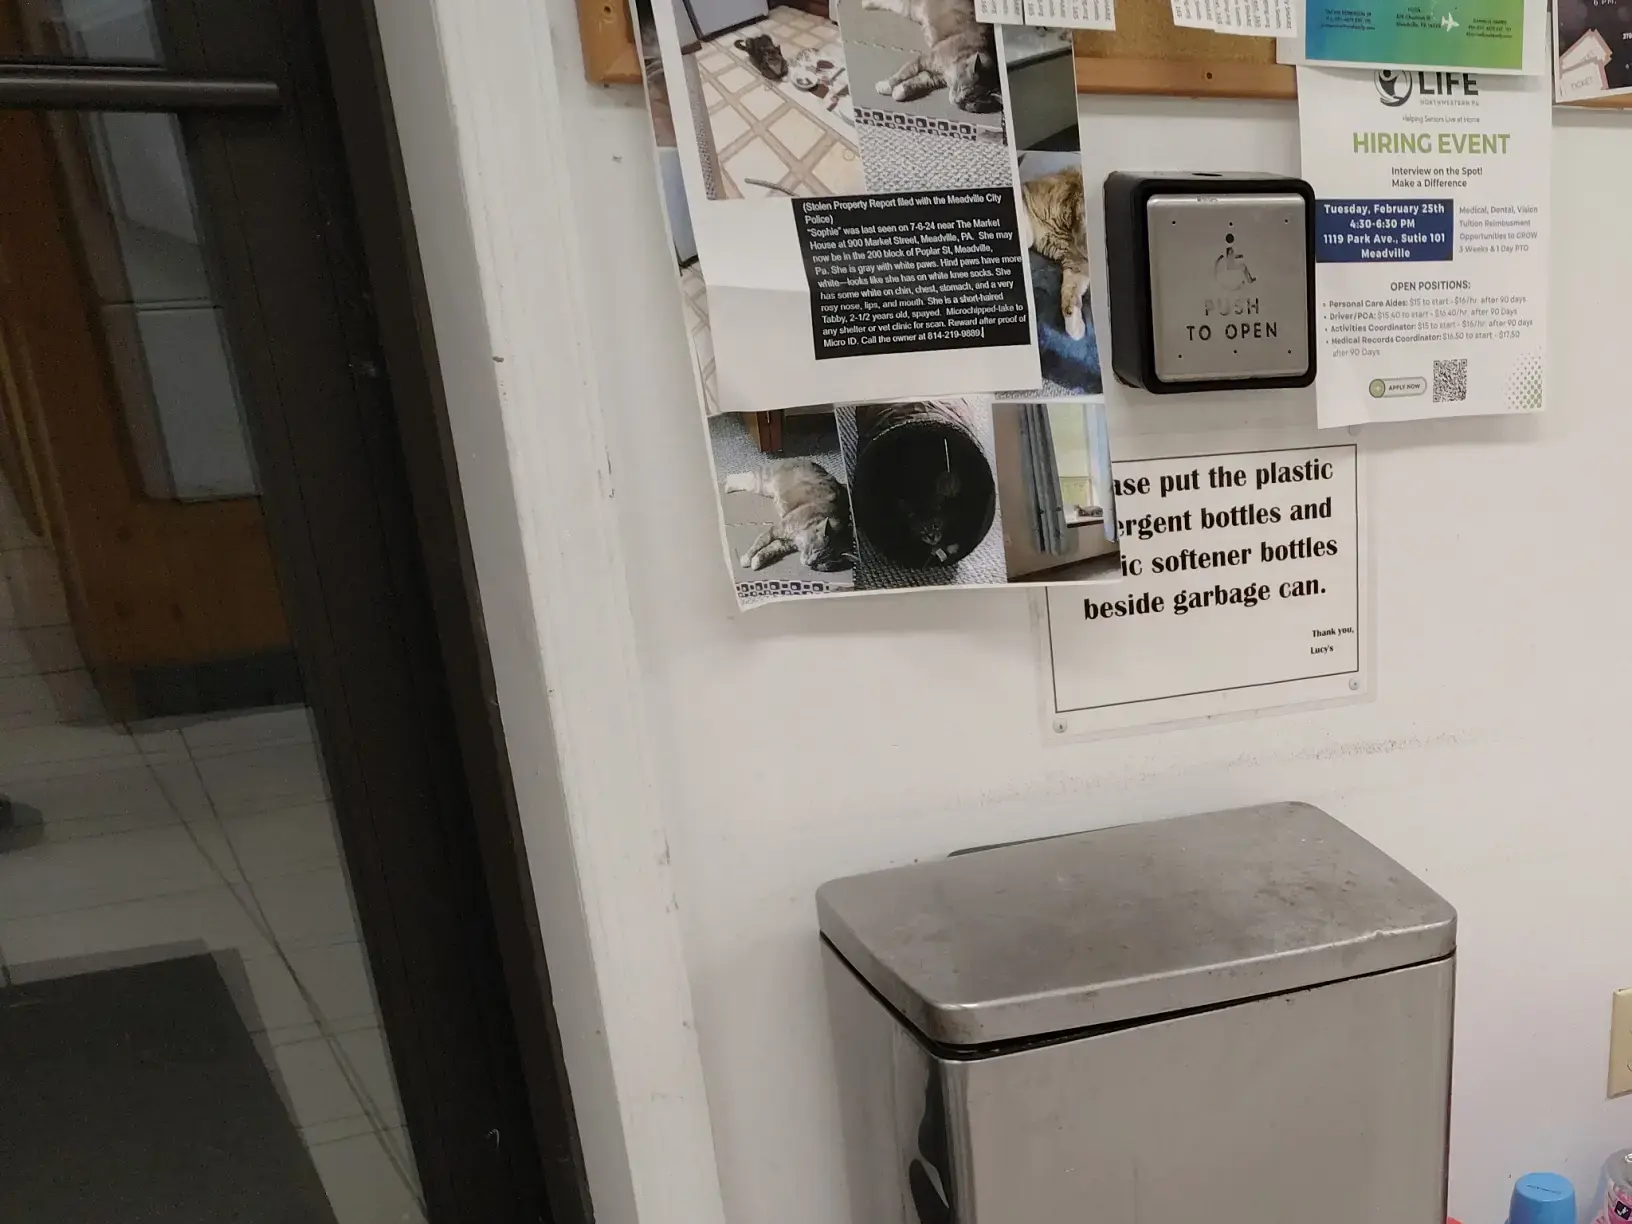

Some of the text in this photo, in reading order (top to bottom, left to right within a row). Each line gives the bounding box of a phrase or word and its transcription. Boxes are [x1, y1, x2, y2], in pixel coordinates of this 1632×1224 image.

[1418, 72, 1479, 96] LIFE
[1353, 132, 1511, 154] HIRING EVENT
[1391, 167, 1432, 175] Interview
[1446, 167, 1459, 175] the
[1462, 167, 1483, 177] Spot!
[1392, 179, 1415, 187] Make
[1424, 179, 1467, 187] Difference
[803, 194, 1001, 213] (Stolen Property Report filed with the Meadville City
[1324, 204, 1445, 215] Tuesday, February 25th
[805, 215, 833, 224] Police)
[843, 227, 860, 235] was
[861, 226, 876, 234] last
[937, 222, 955, 230] near
[956, 220, 972, 228] The
[973, 219, 1000, 228] Market
[1349, 219, 1415, 228] 4:30-6:30 PM
[810, 241, 836, 250] House
[838, 240, 846, 248] at
[848, 239, 863, 247] 900
[865, 237, 892, 247] Market
[893, 235, 919, 244] Street,
[921, 233, 960, 243] Meadville,
[996, 232, 1012, 240] may
[1323, 234, 1344, 244] 1119
[1347, 234, 1370, 244] Park
[1430, 233, 1445, 243] 101
[1460, 232, 1506, 241] Opportunities
[853, 251, 865, 260] the
[867, 251, 882, 259] 200
[884, 249, 904, 257] block
[906, 248, 914, 256] of
[915, 247, 940, 257] Poplar
[955, 244, 993, 254] Meadville,
[1361, 249, 1410, 259] Meadville
[1390, 280, 1471, 291] OPEN POSITIONS:
[864, 301, 880, 310] lips,
[883, 300, 897, 308] and
[928, 297, 943, 305] She
[945, 296, 951, 304] is
[960, 292, 1004, 303] short-haired
[1205, 298, 1259, 316] PUSH
[1329, 300, 1364, 308] Personal
[822, 315, 847, 324] Tabby,
[850, 313, 870, 321] 2-1/2
[872, 313, 894, 321] years
[896, 311, 910, 319] old,
[912, 309, 941, 318] spayed.
[1330, 312, 1376, 320] Driver/PCA:
[1186, 322, 1277, 341] TO OPEN
[1332, 336, 1360, 344] Medical
[1395, 332, 1441, 343] Coordinator:
[824, 339, 845, 348] Micro
[861, 336, 876, 345] Call
[878, 335, 890, 343] the
[892, 334, 916, 342] owner
[919, 332, 926, 340] at
[1113, 458, 1334, 498] ase put the plastic
[1117, 497, 1332, 540] ergent bottles and
[1152, 548, 1252, 574] softener
[1260, 537, 1338, 563] bottles
[1084, 579, 1327, 621] beside garbage can.
[1312, 626, 1355, 638] Thank you,
[1310, 645, 1334, 655] Lucy's
